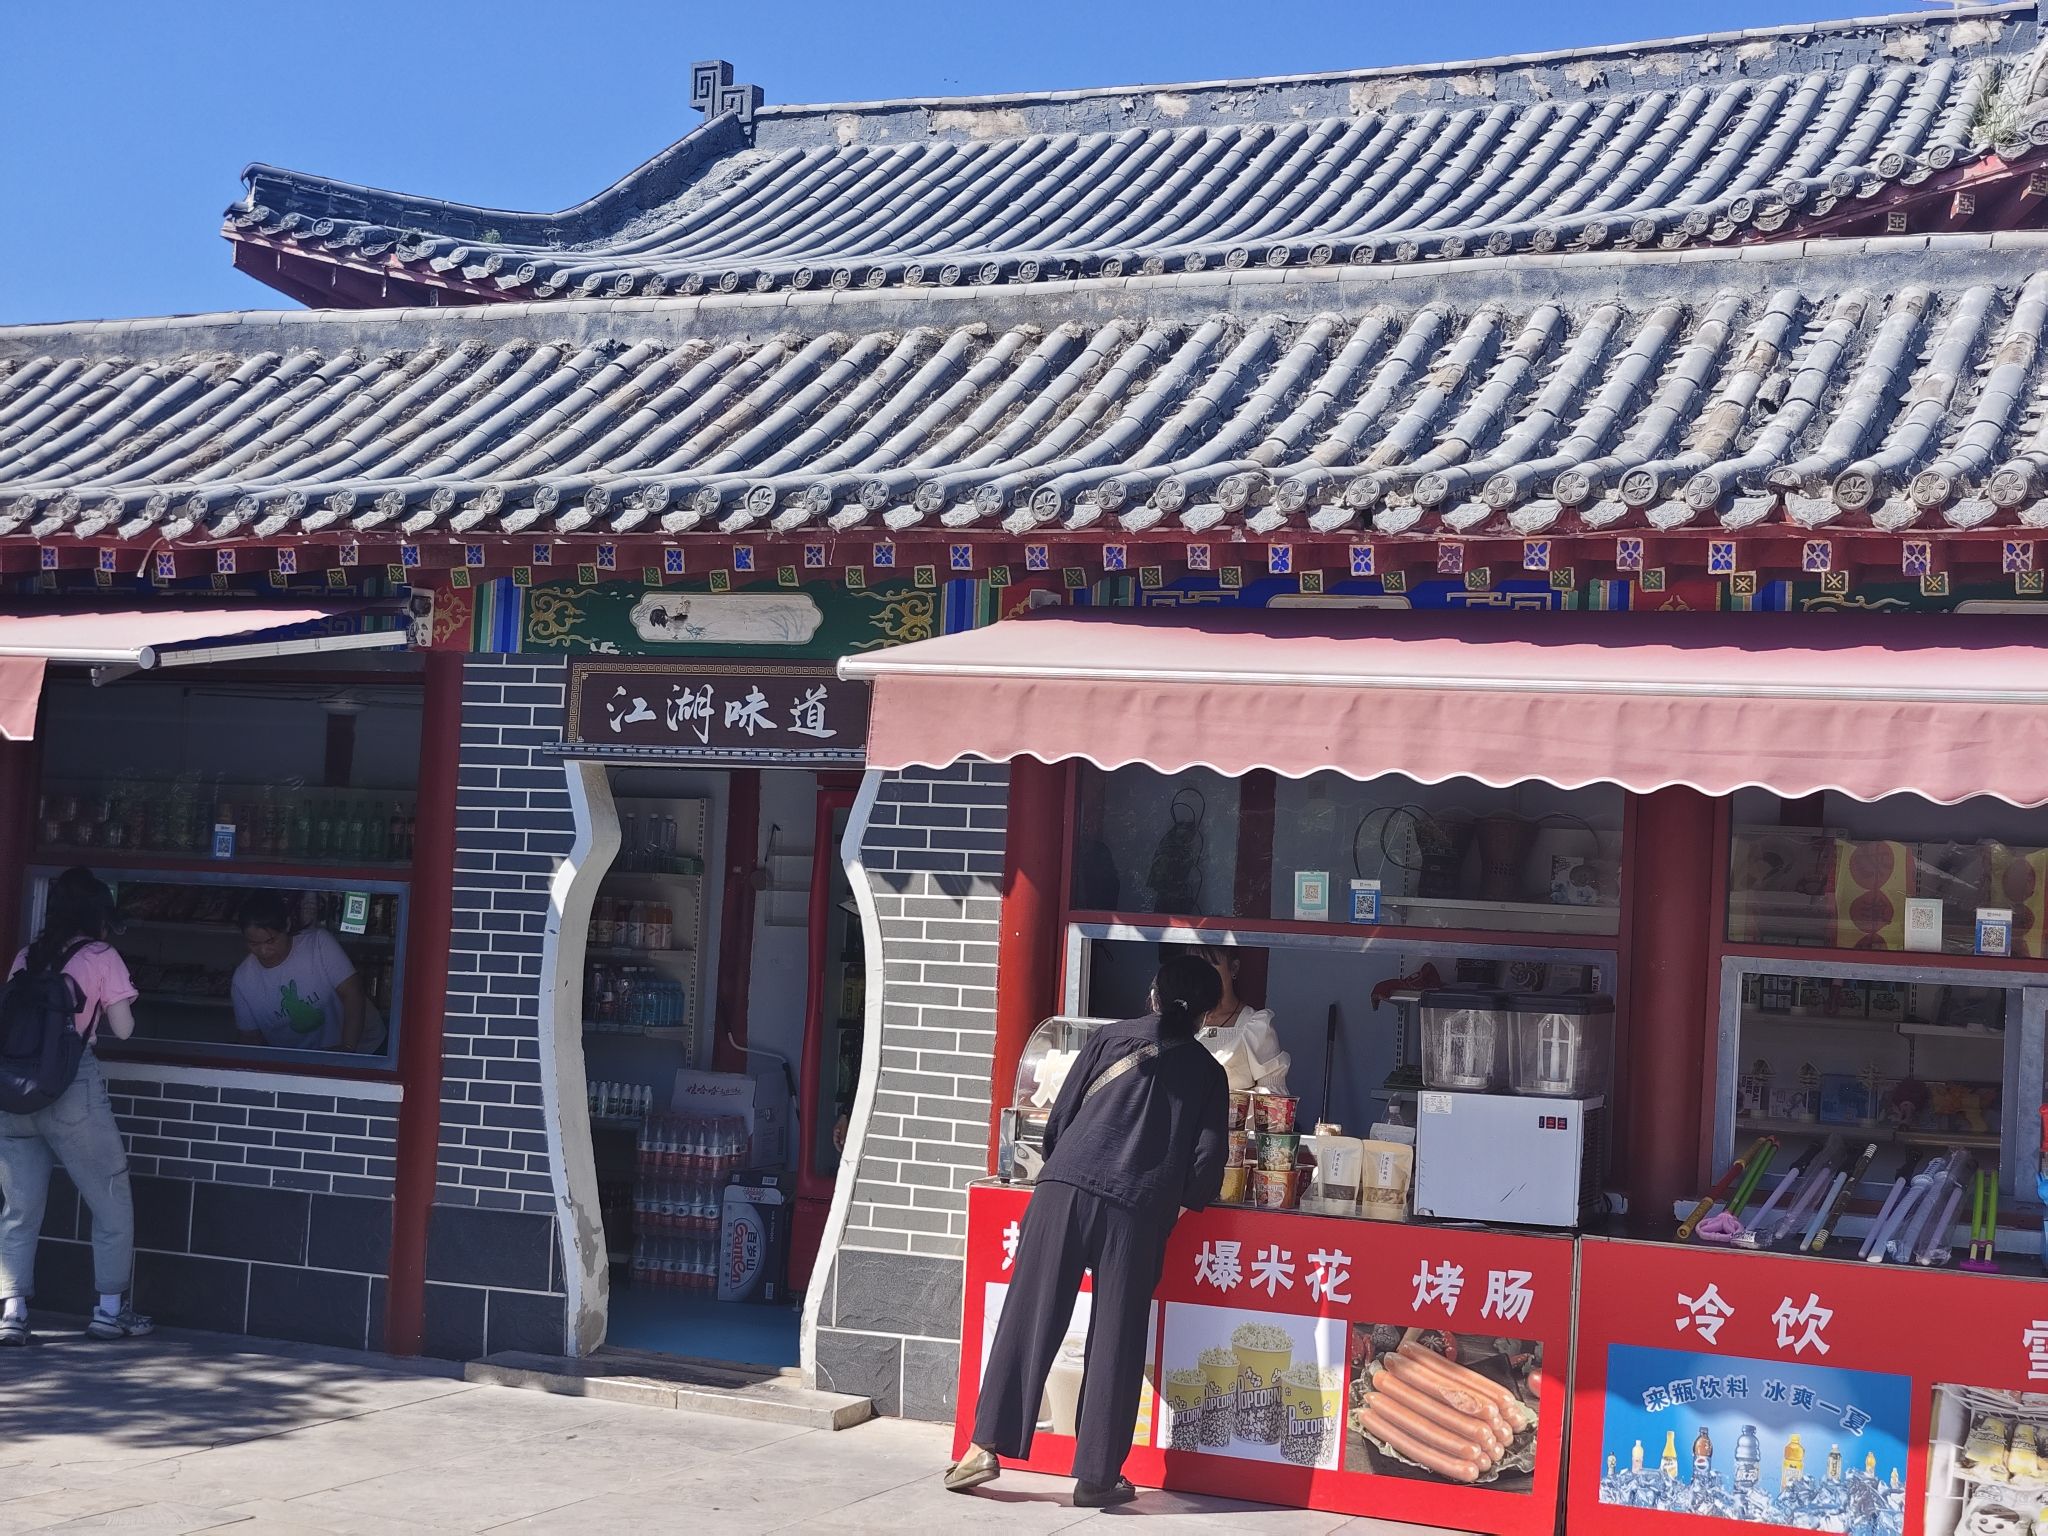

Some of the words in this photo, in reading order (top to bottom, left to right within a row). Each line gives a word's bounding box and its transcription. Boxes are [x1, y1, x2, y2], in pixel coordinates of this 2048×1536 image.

[606, 683, 838, 745] 江湖味道
[1193, 1240, 1353, 1305] 爆米花
[1411, 1259, 1535, 1324] 烤肠
[1675, 1282, 1835, 1356] 冷饮
[1237, 1375, 1282, 1411] POPCORN
[1287, 1405, 1332, 1436] POPCORN
[1643, 1376, 1750, 1412] 来瓶饮料
[1763, 1381, 1872, 1437] 冰爽一夏
